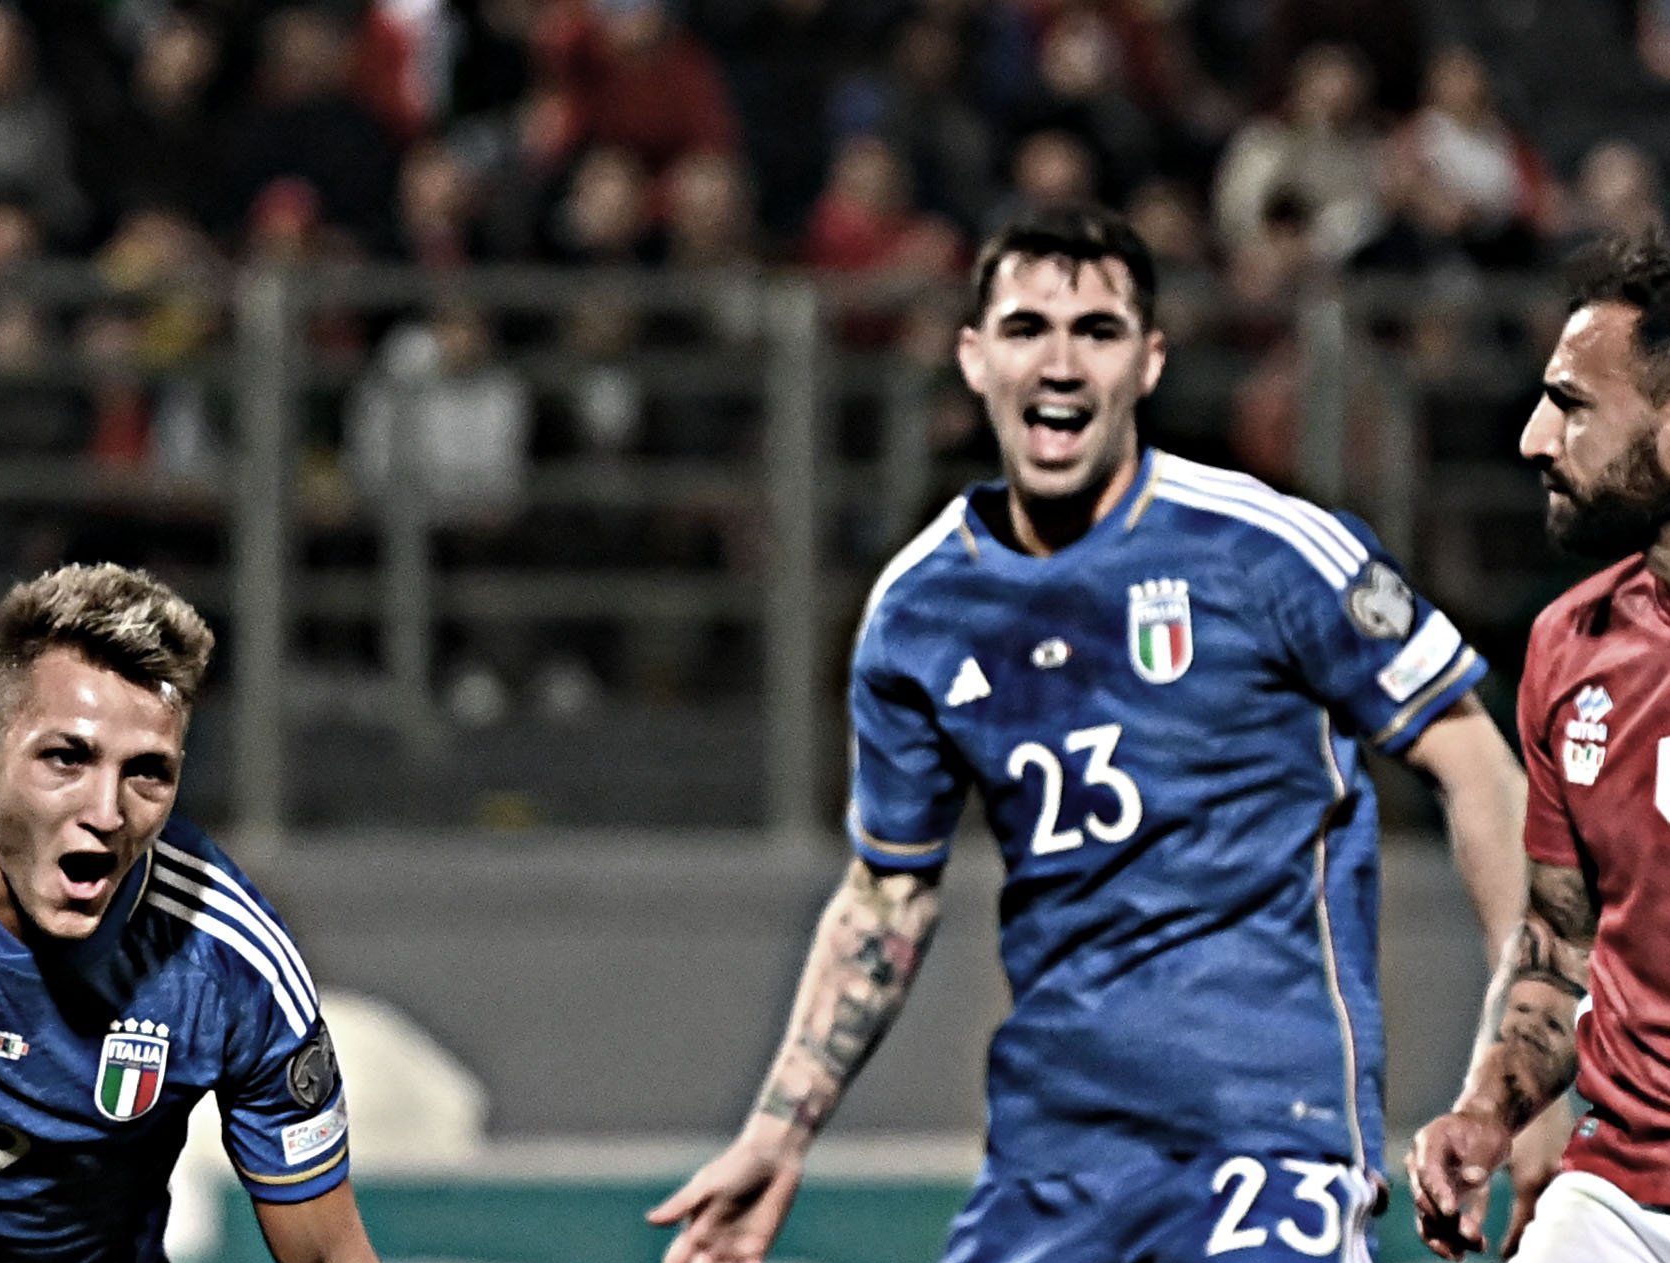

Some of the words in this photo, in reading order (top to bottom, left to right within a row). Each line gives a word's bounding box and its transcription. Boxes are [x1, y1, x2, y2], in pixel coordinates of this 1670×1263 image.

[1006, 722, 1142, 857] 23
[107, 1041, 161, 1064] ITALIA
[1203, 1155, 1342, 1258] 23
